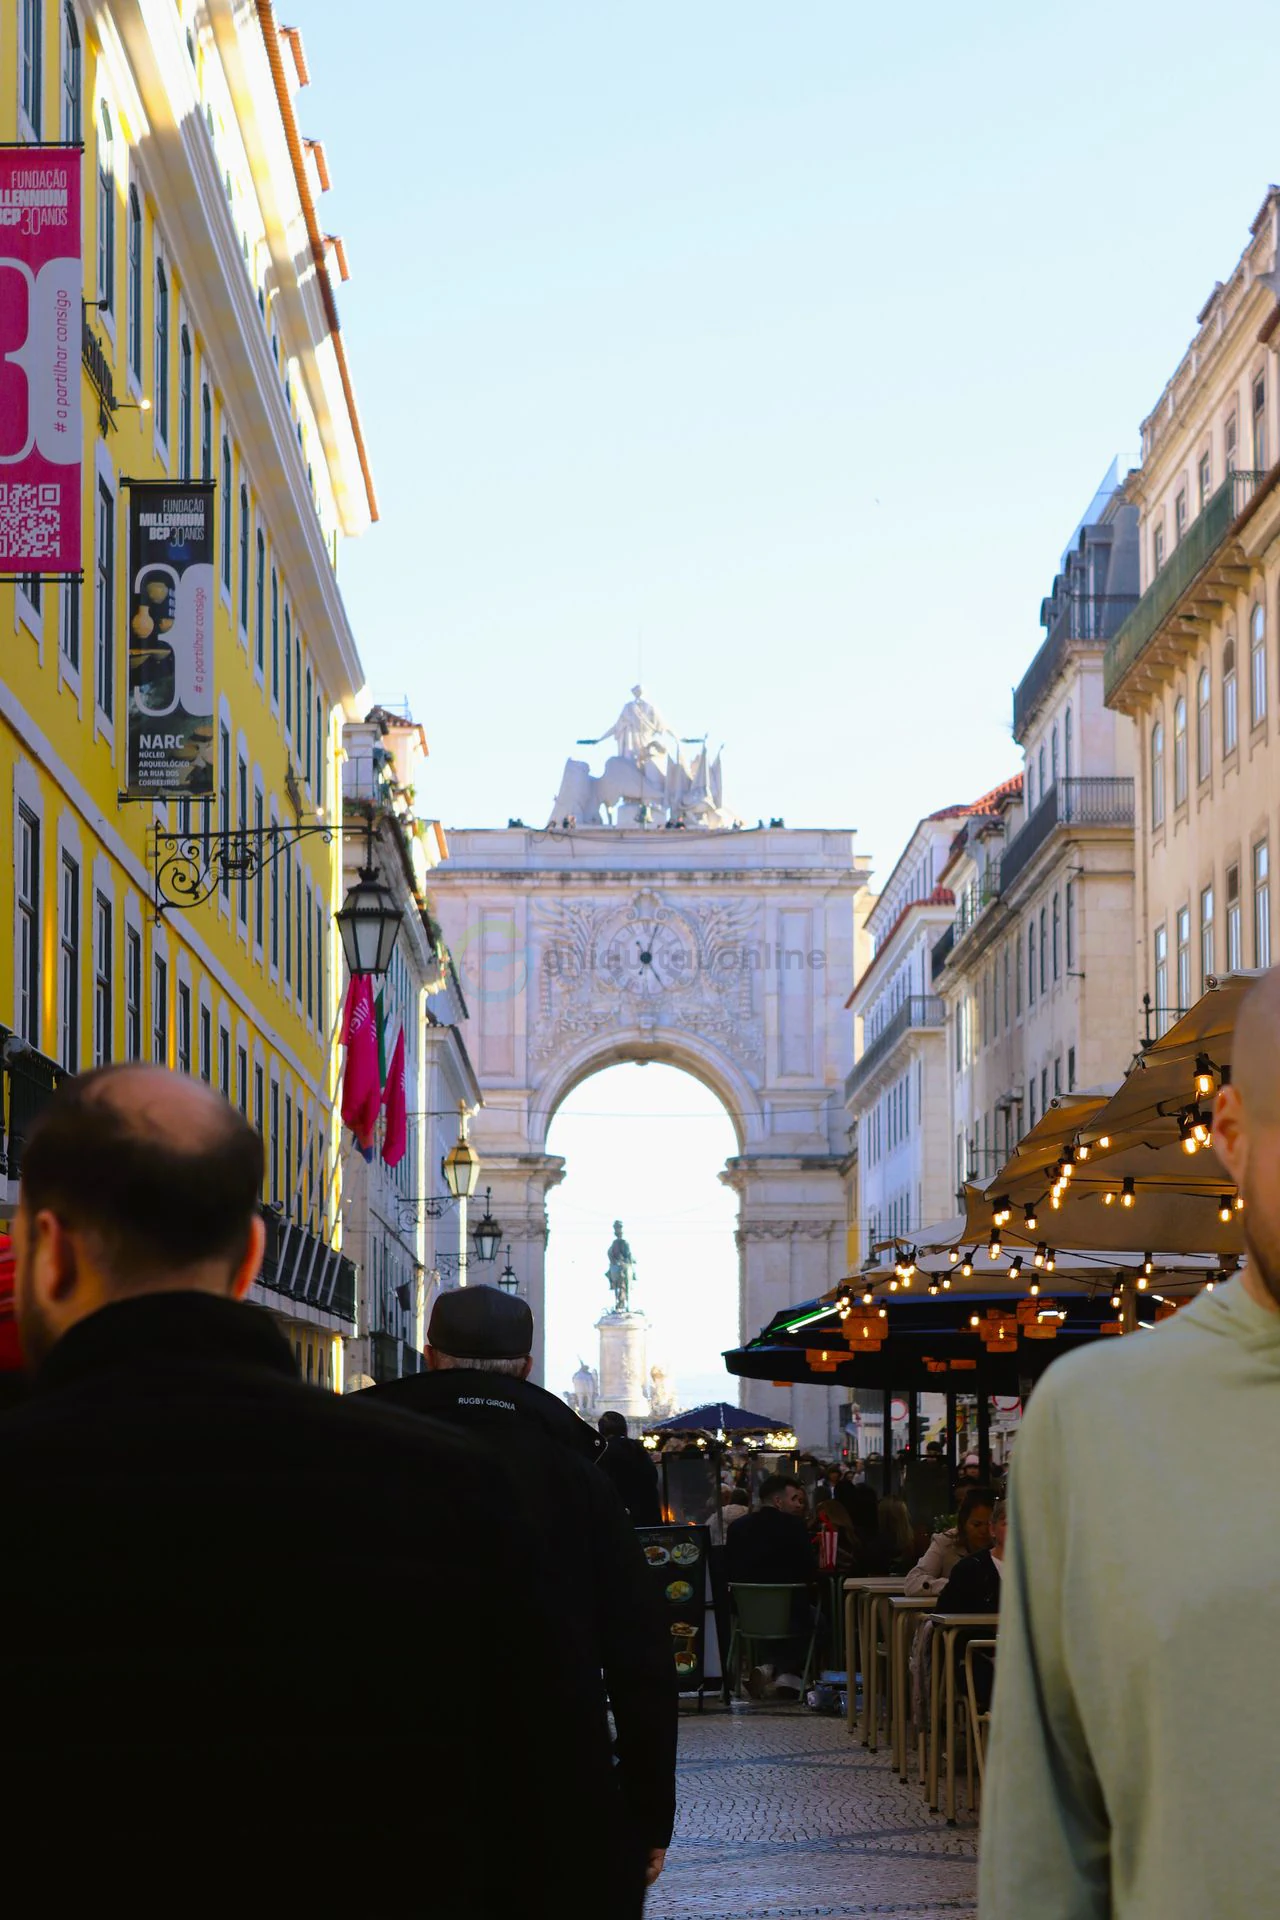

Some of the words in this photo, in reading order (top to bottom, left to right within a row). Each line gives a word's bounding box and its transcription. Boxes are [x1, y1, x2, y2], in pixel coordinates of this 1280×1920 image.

[54, 289, 71, 342] consigo
[53, 345, 70, 407] partilhar
[139, 513, 204, 526] MILLENNIUM
[194, 587, 207, 626] consigo
[192, 628, 206, 673] partilhar
[140, 734, 184, 749] NARC
[458, 1397, 485, 1405] RUGBY
[485, 1398, 516, 1411] GIRONA
